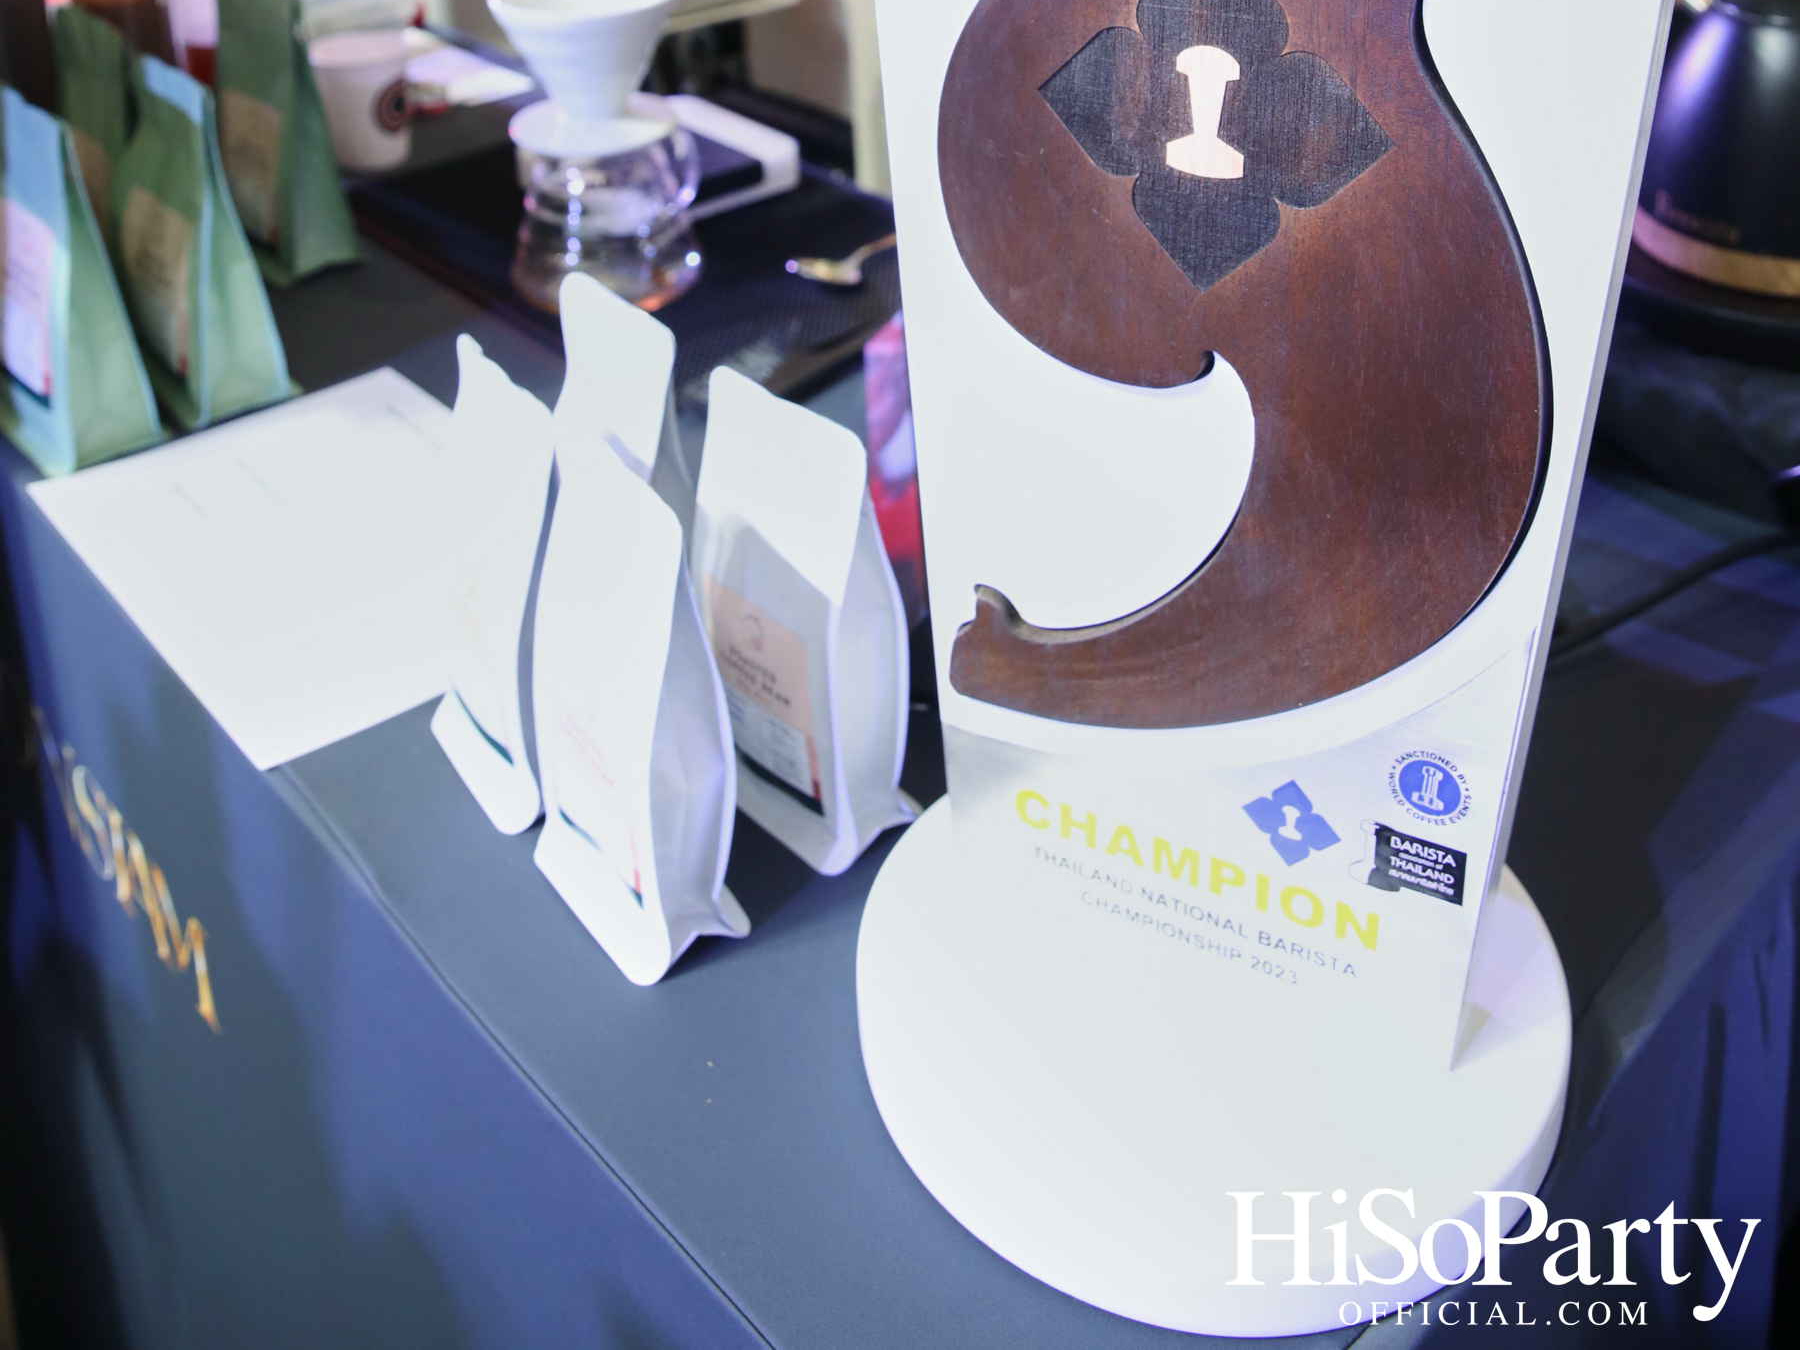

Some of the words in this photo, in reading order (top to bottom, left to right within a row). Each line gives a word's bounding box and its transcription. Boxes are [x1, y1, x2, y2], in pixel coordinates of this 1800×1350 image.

[1395, 750, 1458, 773] SANCTIONED
[1457, 774, 1468, 785] BY
[1388, 772, 1405, 807] WORLD
[1406, 808, 1448, 826] COFFEE
[1449, 794, 1472, 824] EVENTS
[1016, 789, 1380, 952] CHAMPION
[1389, 855, 1455, 885] THAILAND
[1390, 835, 1457, 868] BARISTA
[1034, 846, 1133, 894] THAILAND
[1141, 887, 1250, 940] NATIONAL
[1257, 930, 1357, 979] BARISTA
[1081, 891, 1243, 960] CHAMPIONSHIP
[1250, 955, 1298, 985] 2023
